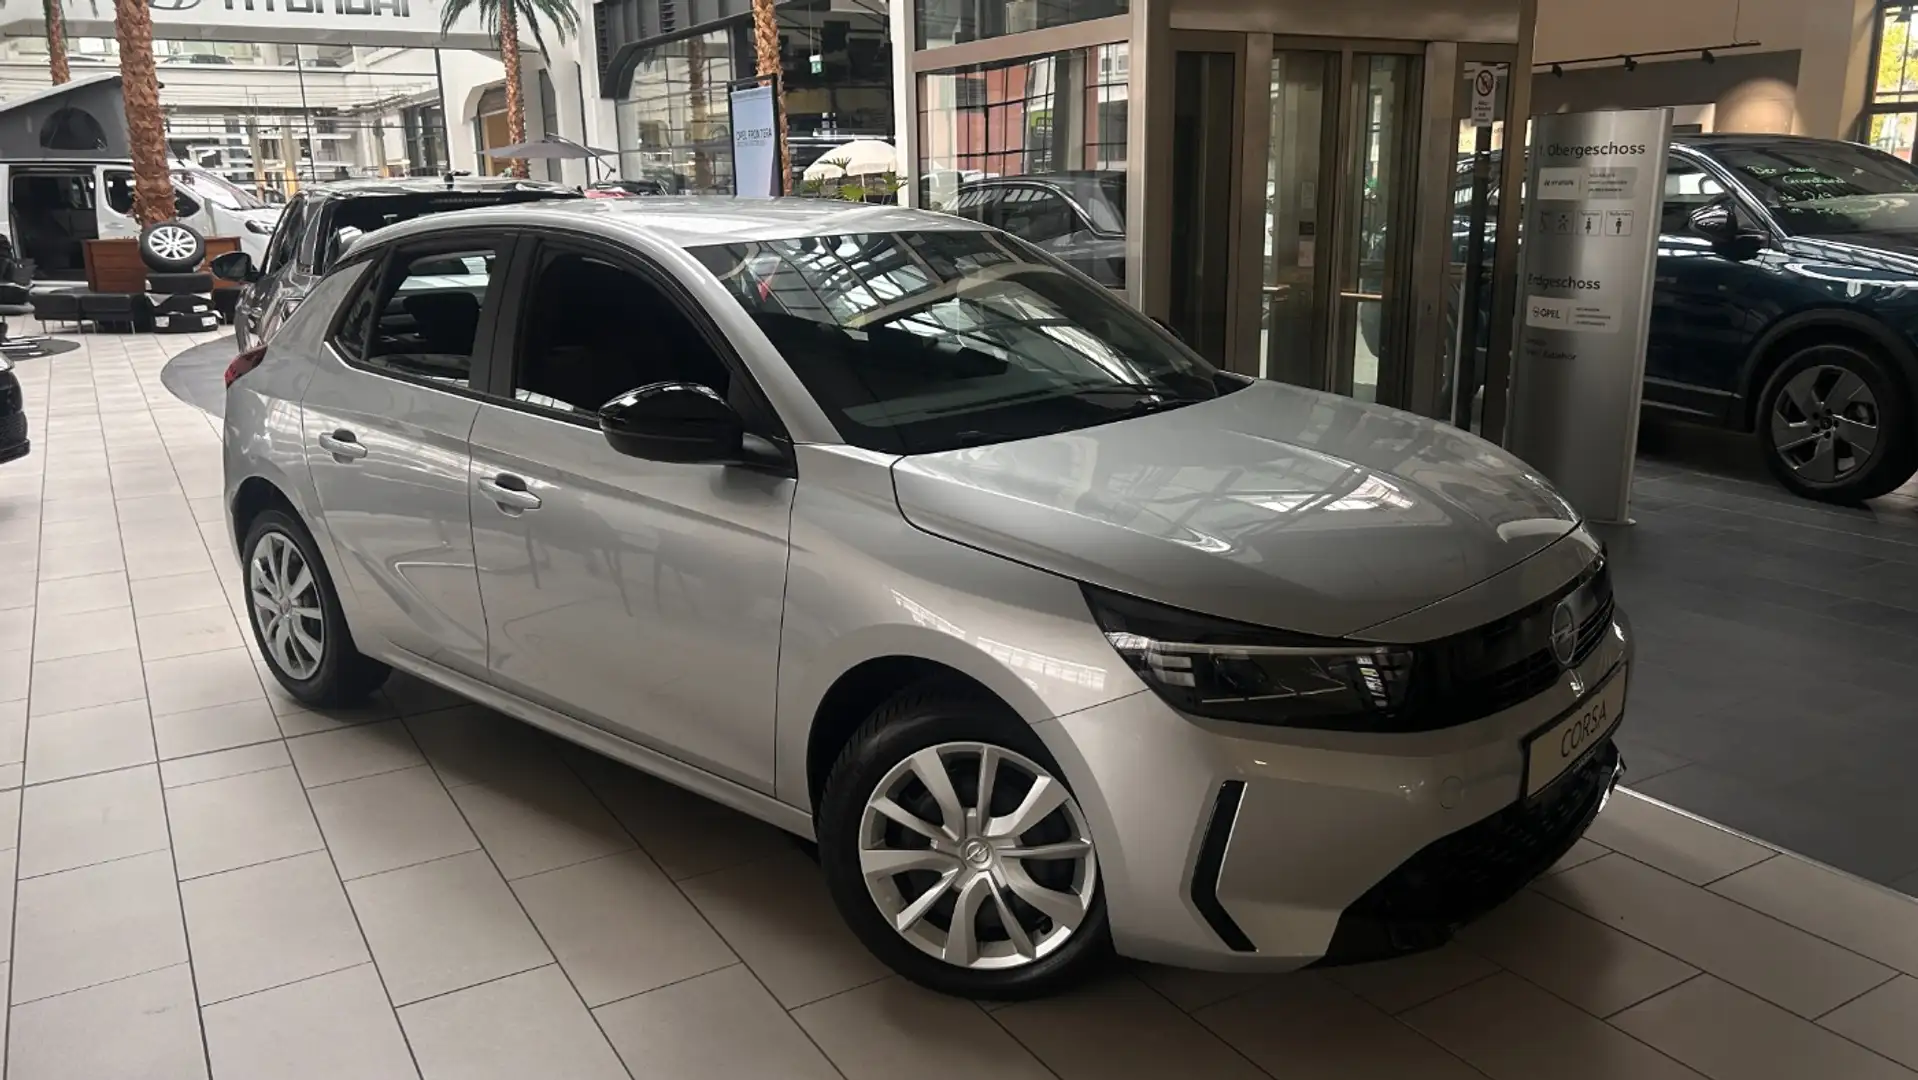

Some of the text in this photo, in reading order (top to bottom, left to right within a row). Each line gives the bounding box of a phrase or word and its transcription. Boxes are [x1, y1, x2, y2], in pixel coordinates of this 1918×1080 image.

[736, 130, 747, 140] OPEL
[1548, 141, 1646, 159] Obergeschoss
[1528, 274, 1601, 291] Erdgeschoss
[1540, 307, 1561, 319] OPEL
[1561, 700, 1607, 757] CORSA
